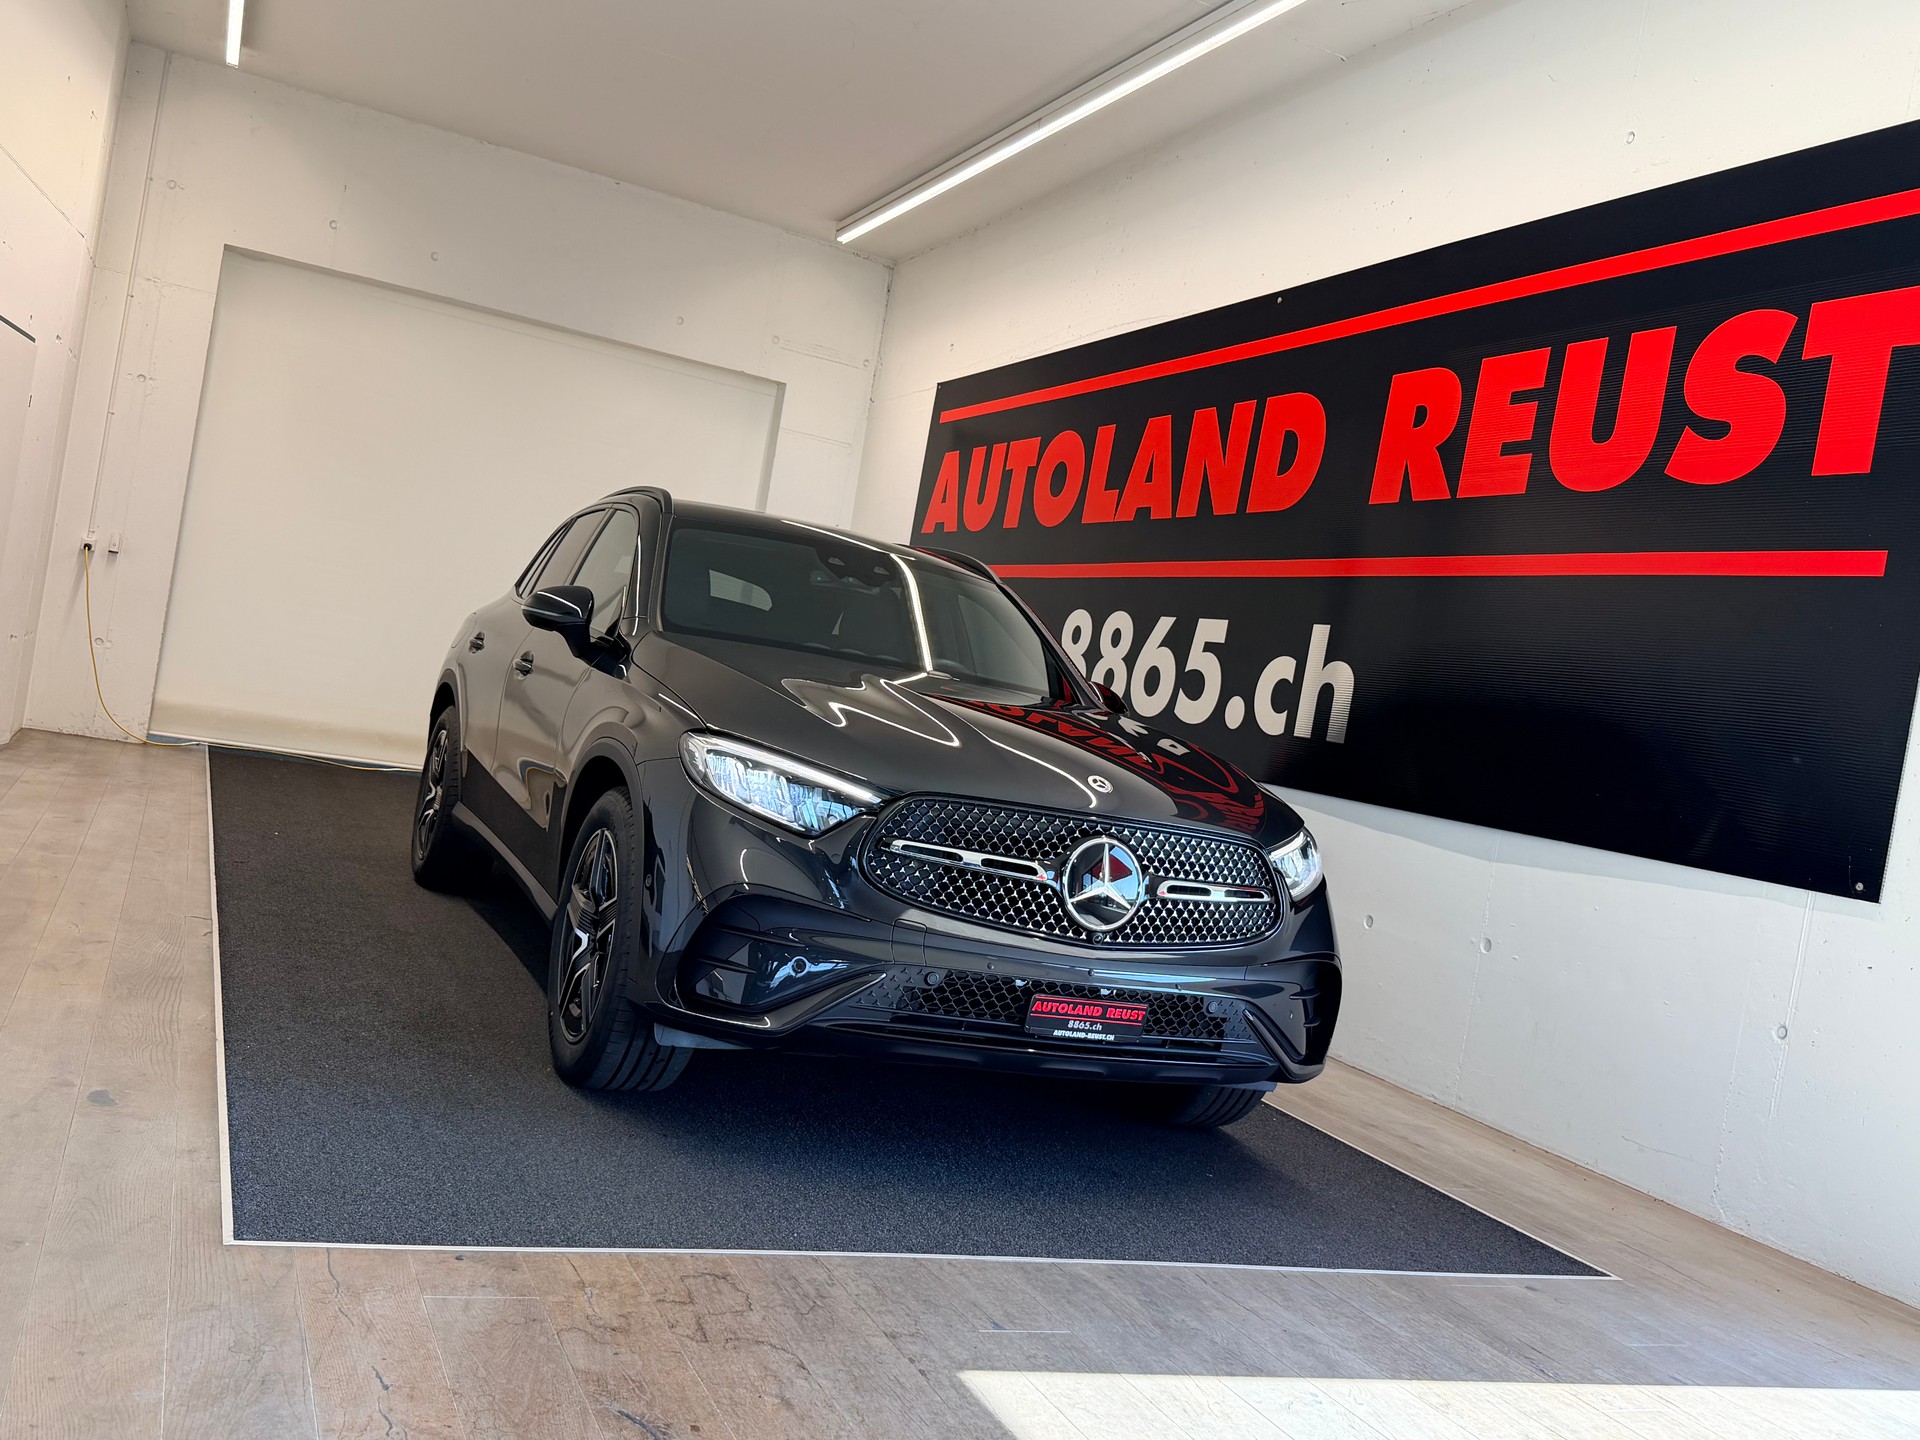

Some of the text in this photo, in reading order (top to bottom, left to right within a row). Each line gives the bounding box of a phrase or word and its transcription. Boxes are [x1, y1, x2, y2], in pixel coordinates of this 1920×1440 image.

[921, 286, 1920, 534] AUTOLAND REUST
[1061, 608, 1355, 744] 8865.ch
[1031, 1001, 1146, 1021] AUTOLAND REUST
[1067, 1020, 1102, 1031] 8865.ch
